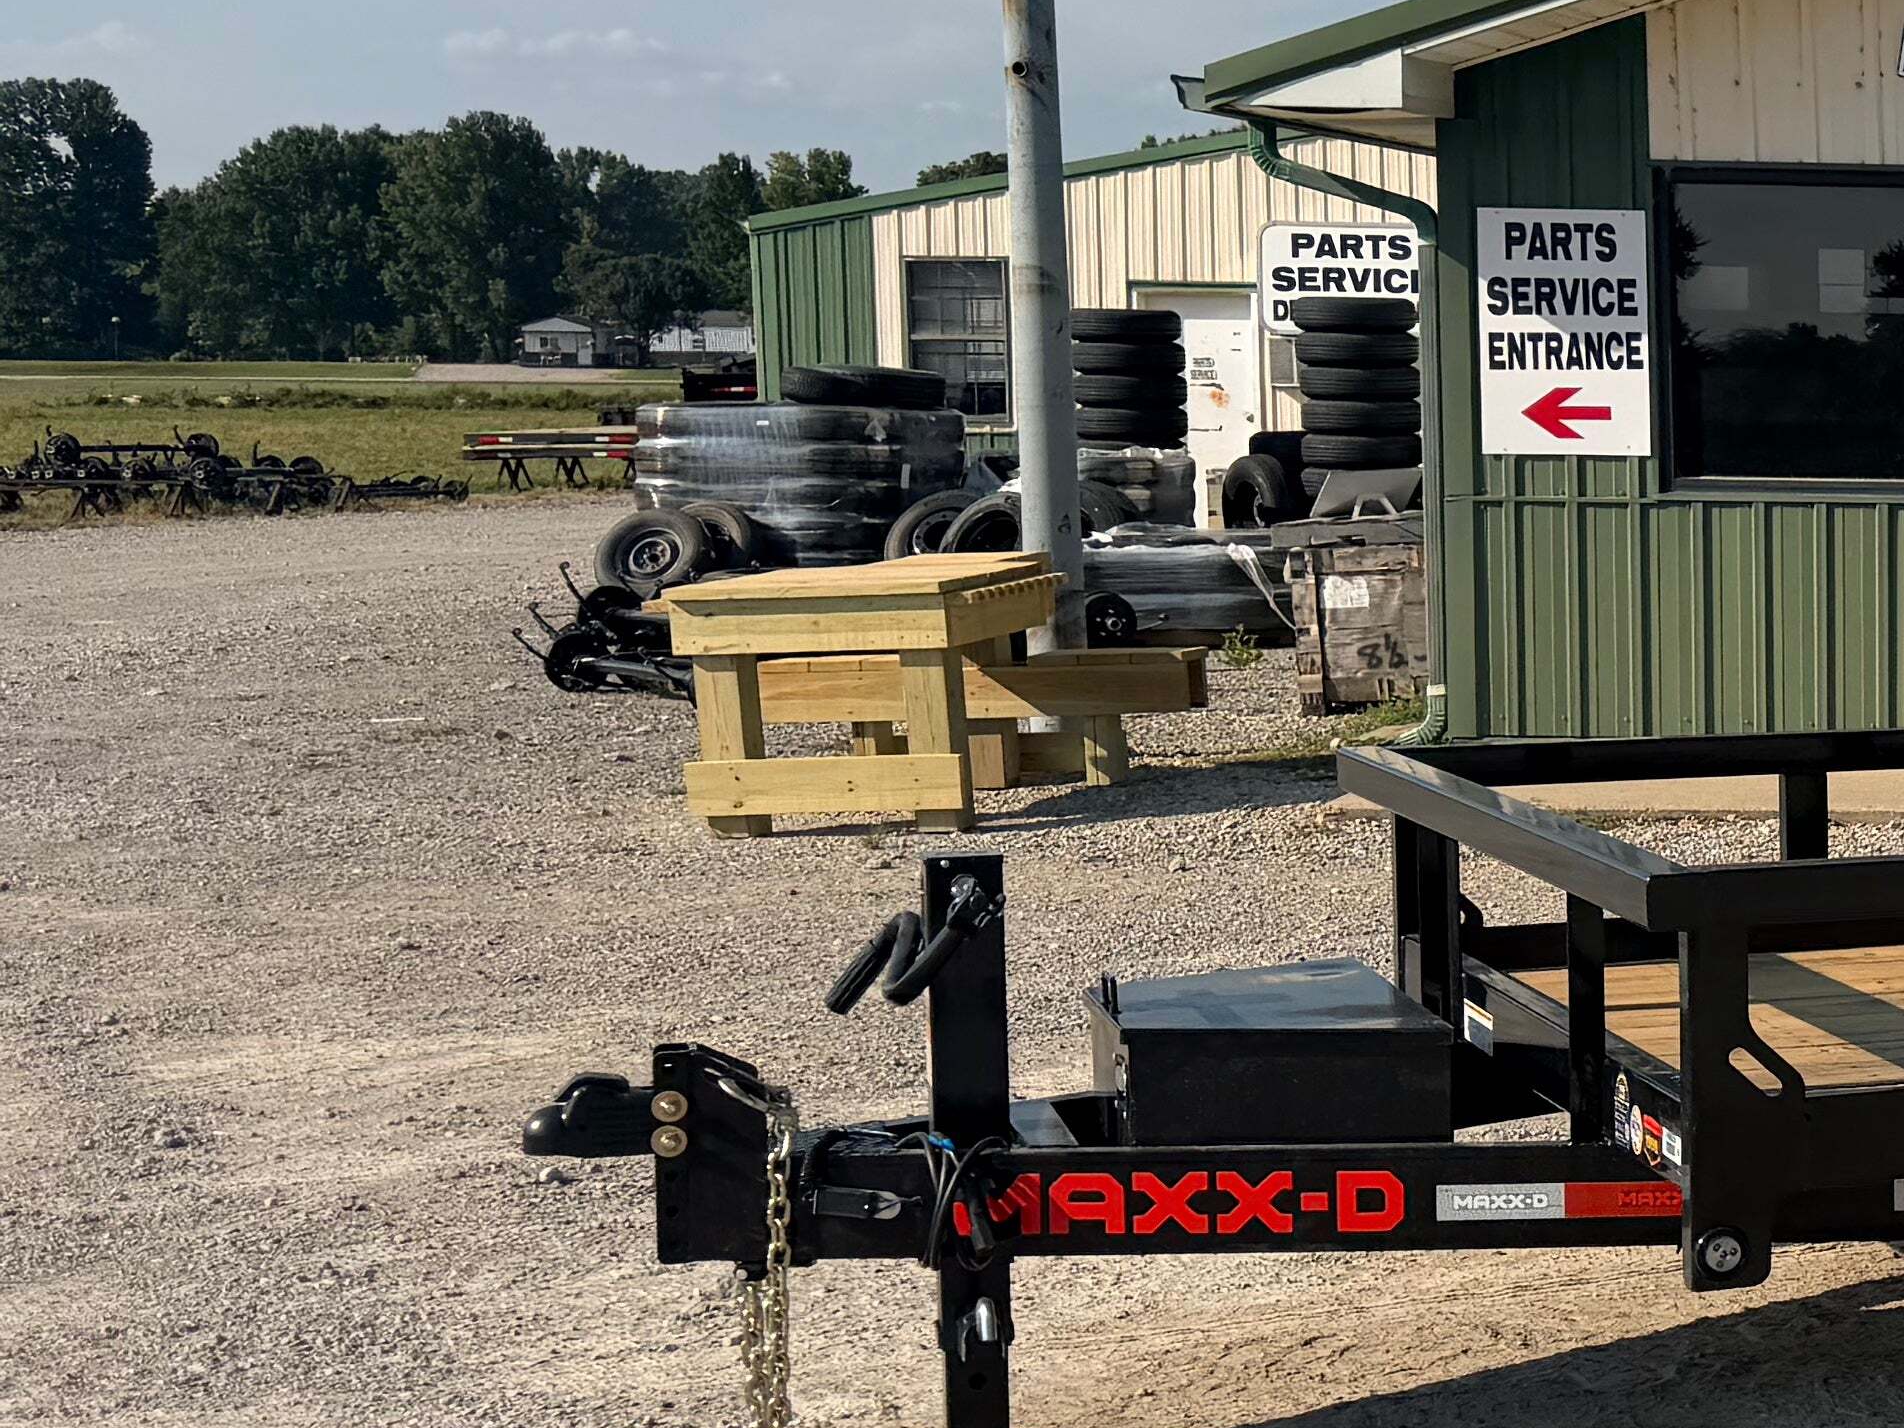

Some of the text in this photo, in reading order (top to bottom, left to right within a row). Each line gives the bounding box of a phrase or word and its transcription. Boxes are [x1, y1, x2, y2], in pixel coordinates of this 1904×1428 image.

[1291, 233, 1413, 260] PARTS
[1504, 222, 1618, 262] PARTS
[1487, 277, 1639, 317] SERVICE
[1488, 331, 1644, 370] ENTRANCE
[1453, 1193, 1549, 1210] MAXX-D
